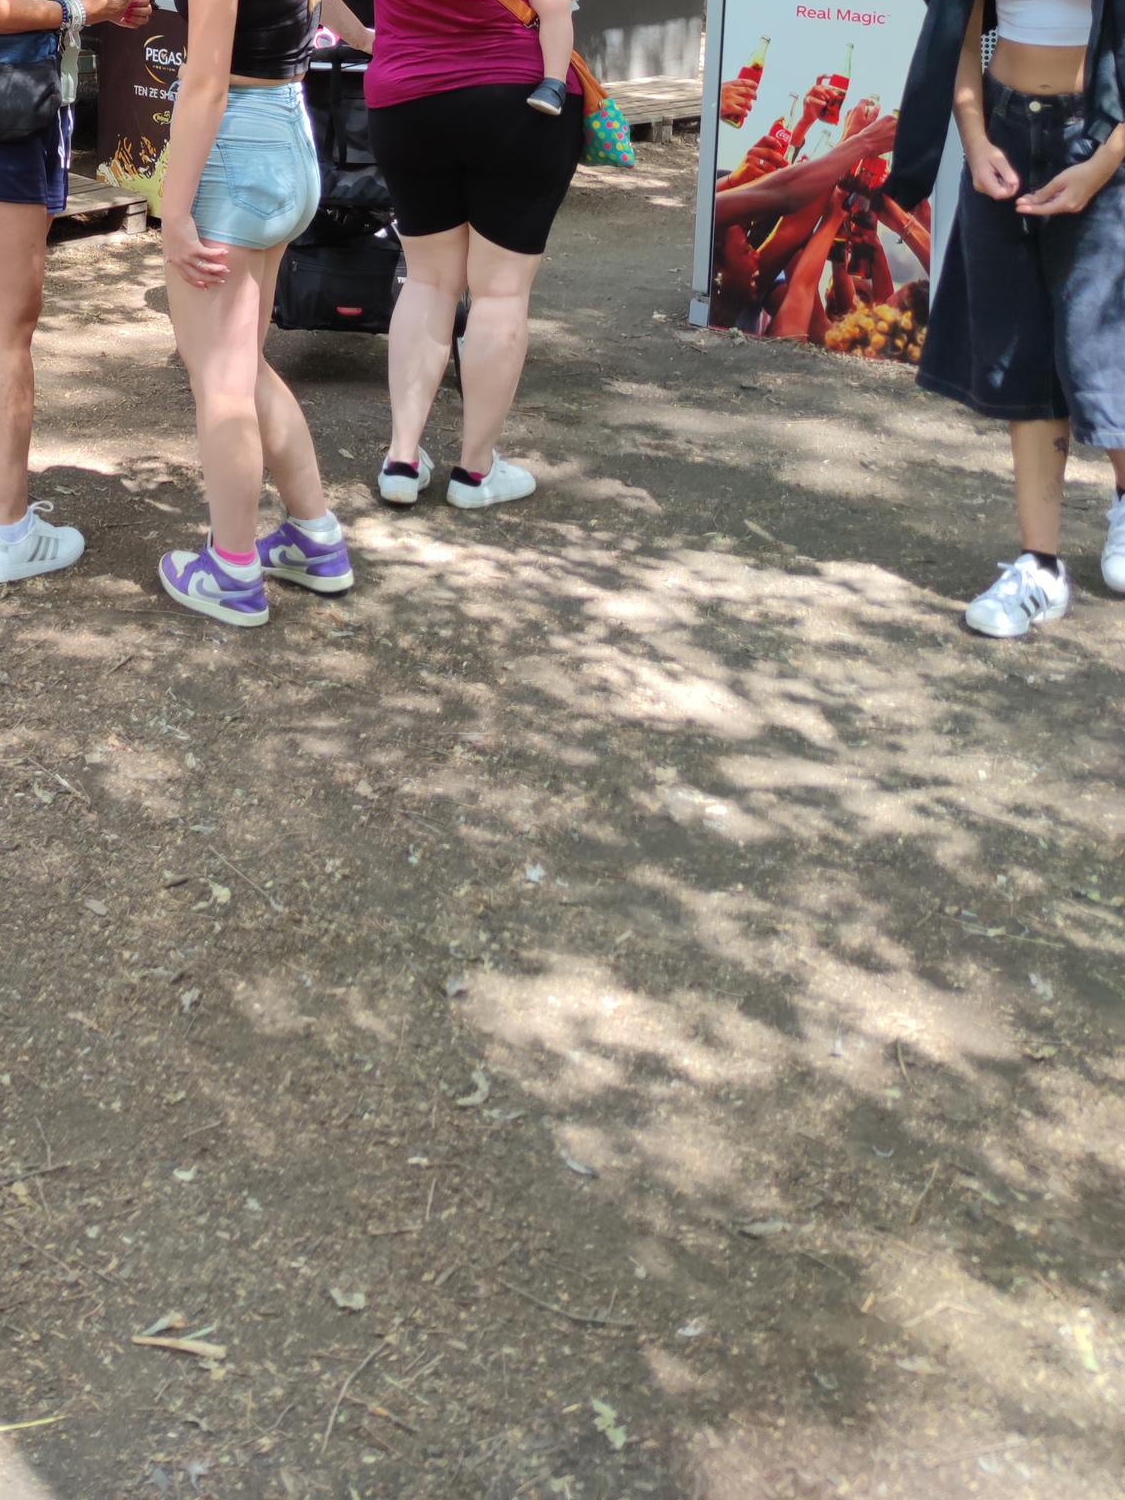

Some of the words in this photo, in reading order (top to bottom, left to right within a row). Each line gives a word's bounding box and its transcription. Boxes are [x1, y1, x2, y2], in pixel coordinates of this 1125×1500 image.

[796, 5, 831, 21] Real
[836, 8, 886, 26] Magic
[145, 47, 182, 66] PEGAS
[134, 85, 148, 98] TEN
